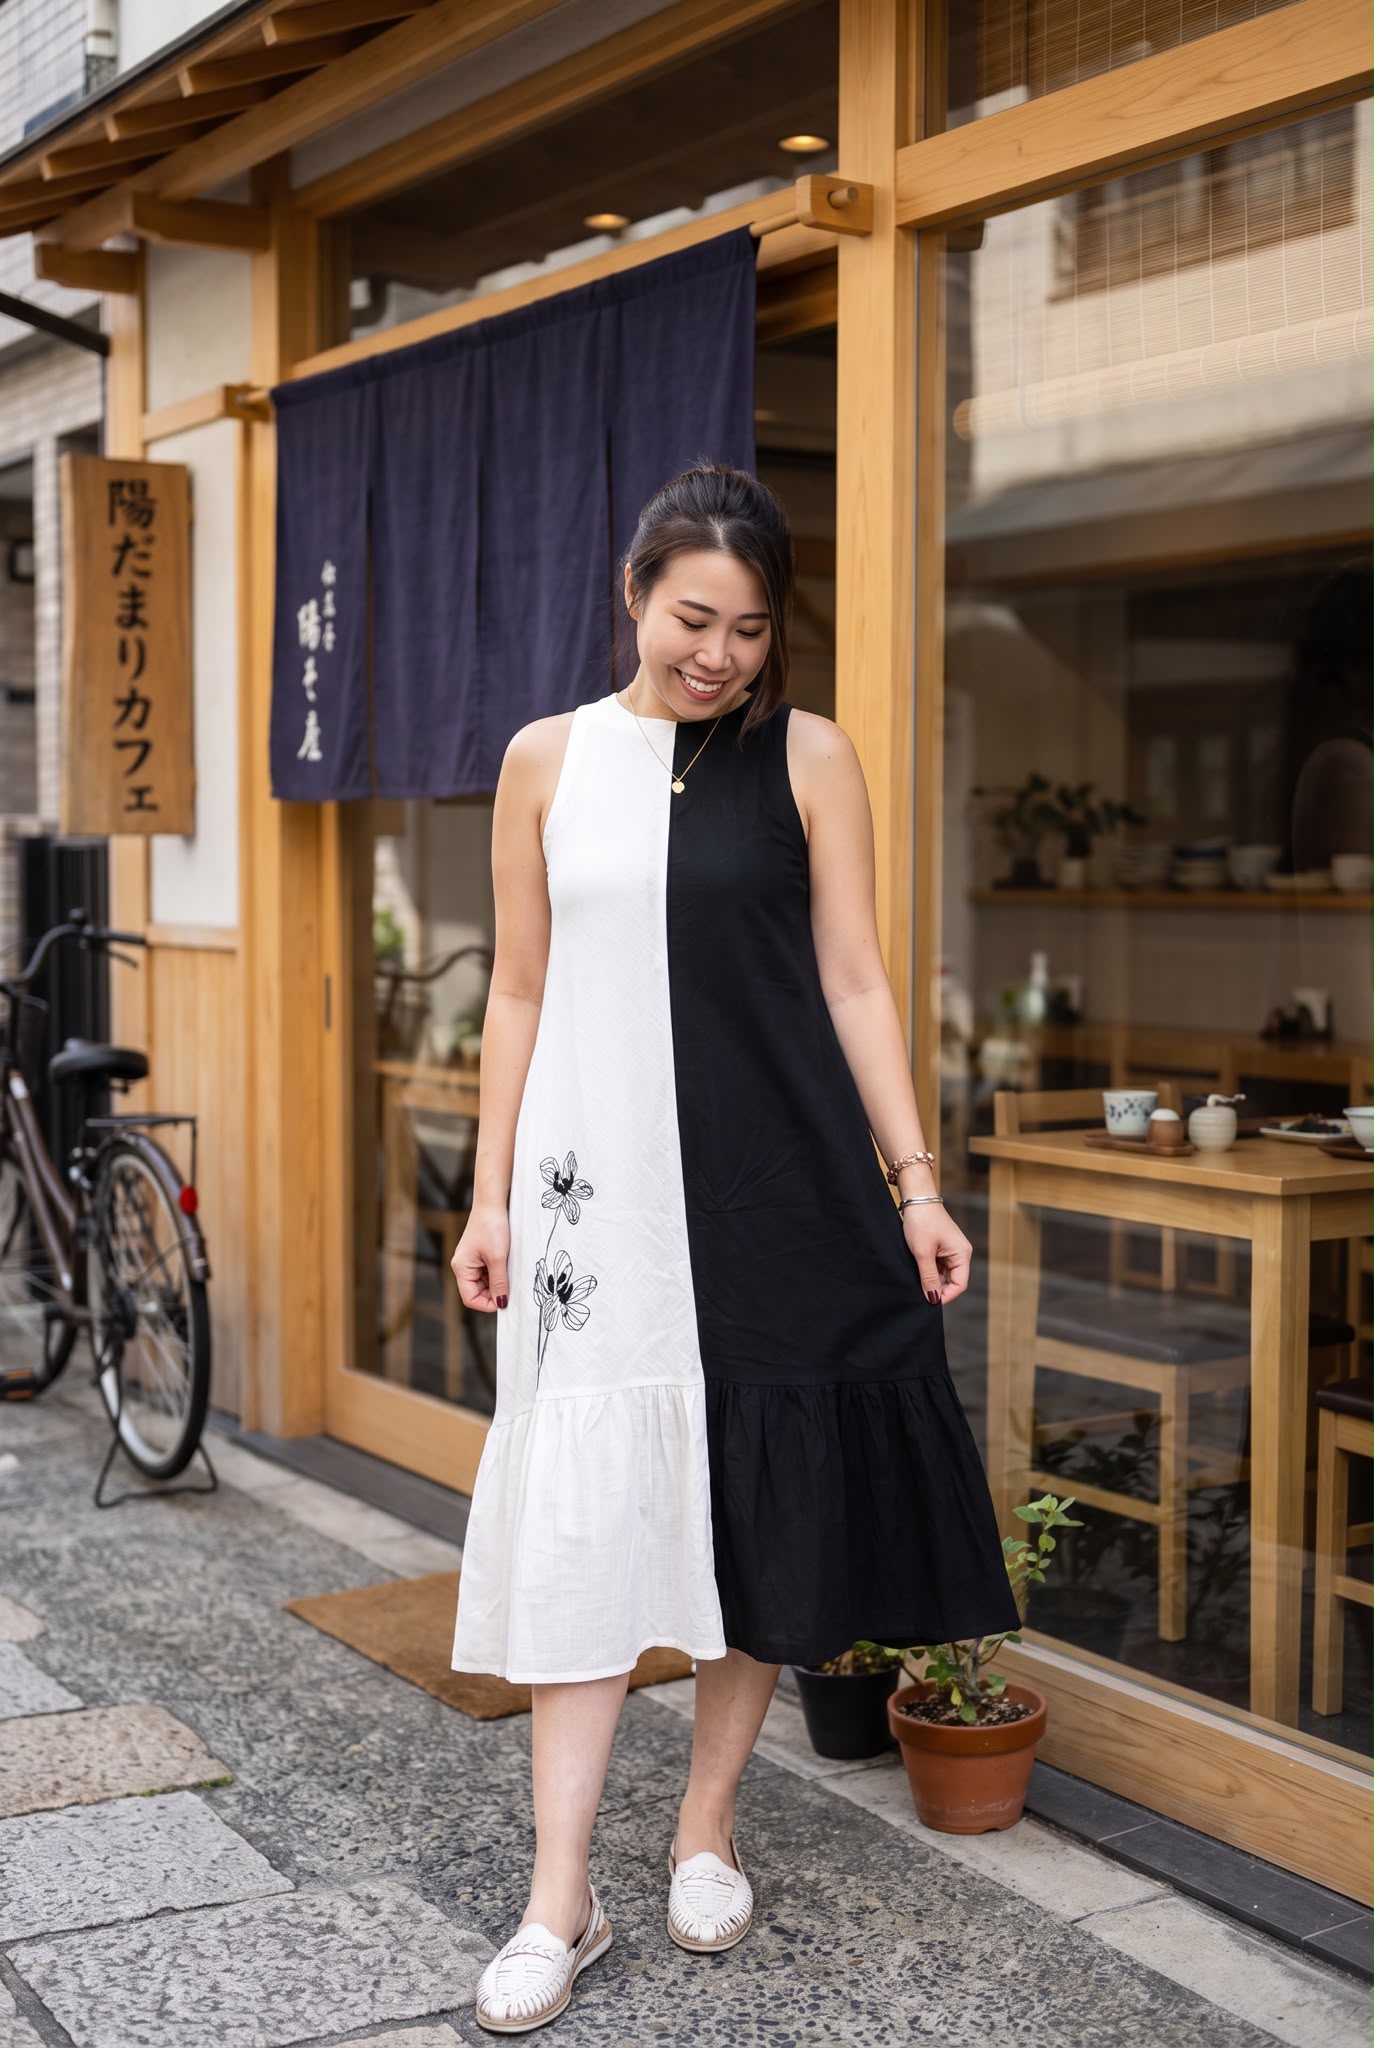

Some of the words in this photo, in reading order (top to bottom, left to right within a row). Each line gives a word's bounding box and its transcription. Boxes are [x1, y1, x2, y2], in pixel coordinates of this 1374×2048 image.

[107, 478, 158, 811] 陽だまりカフェ
